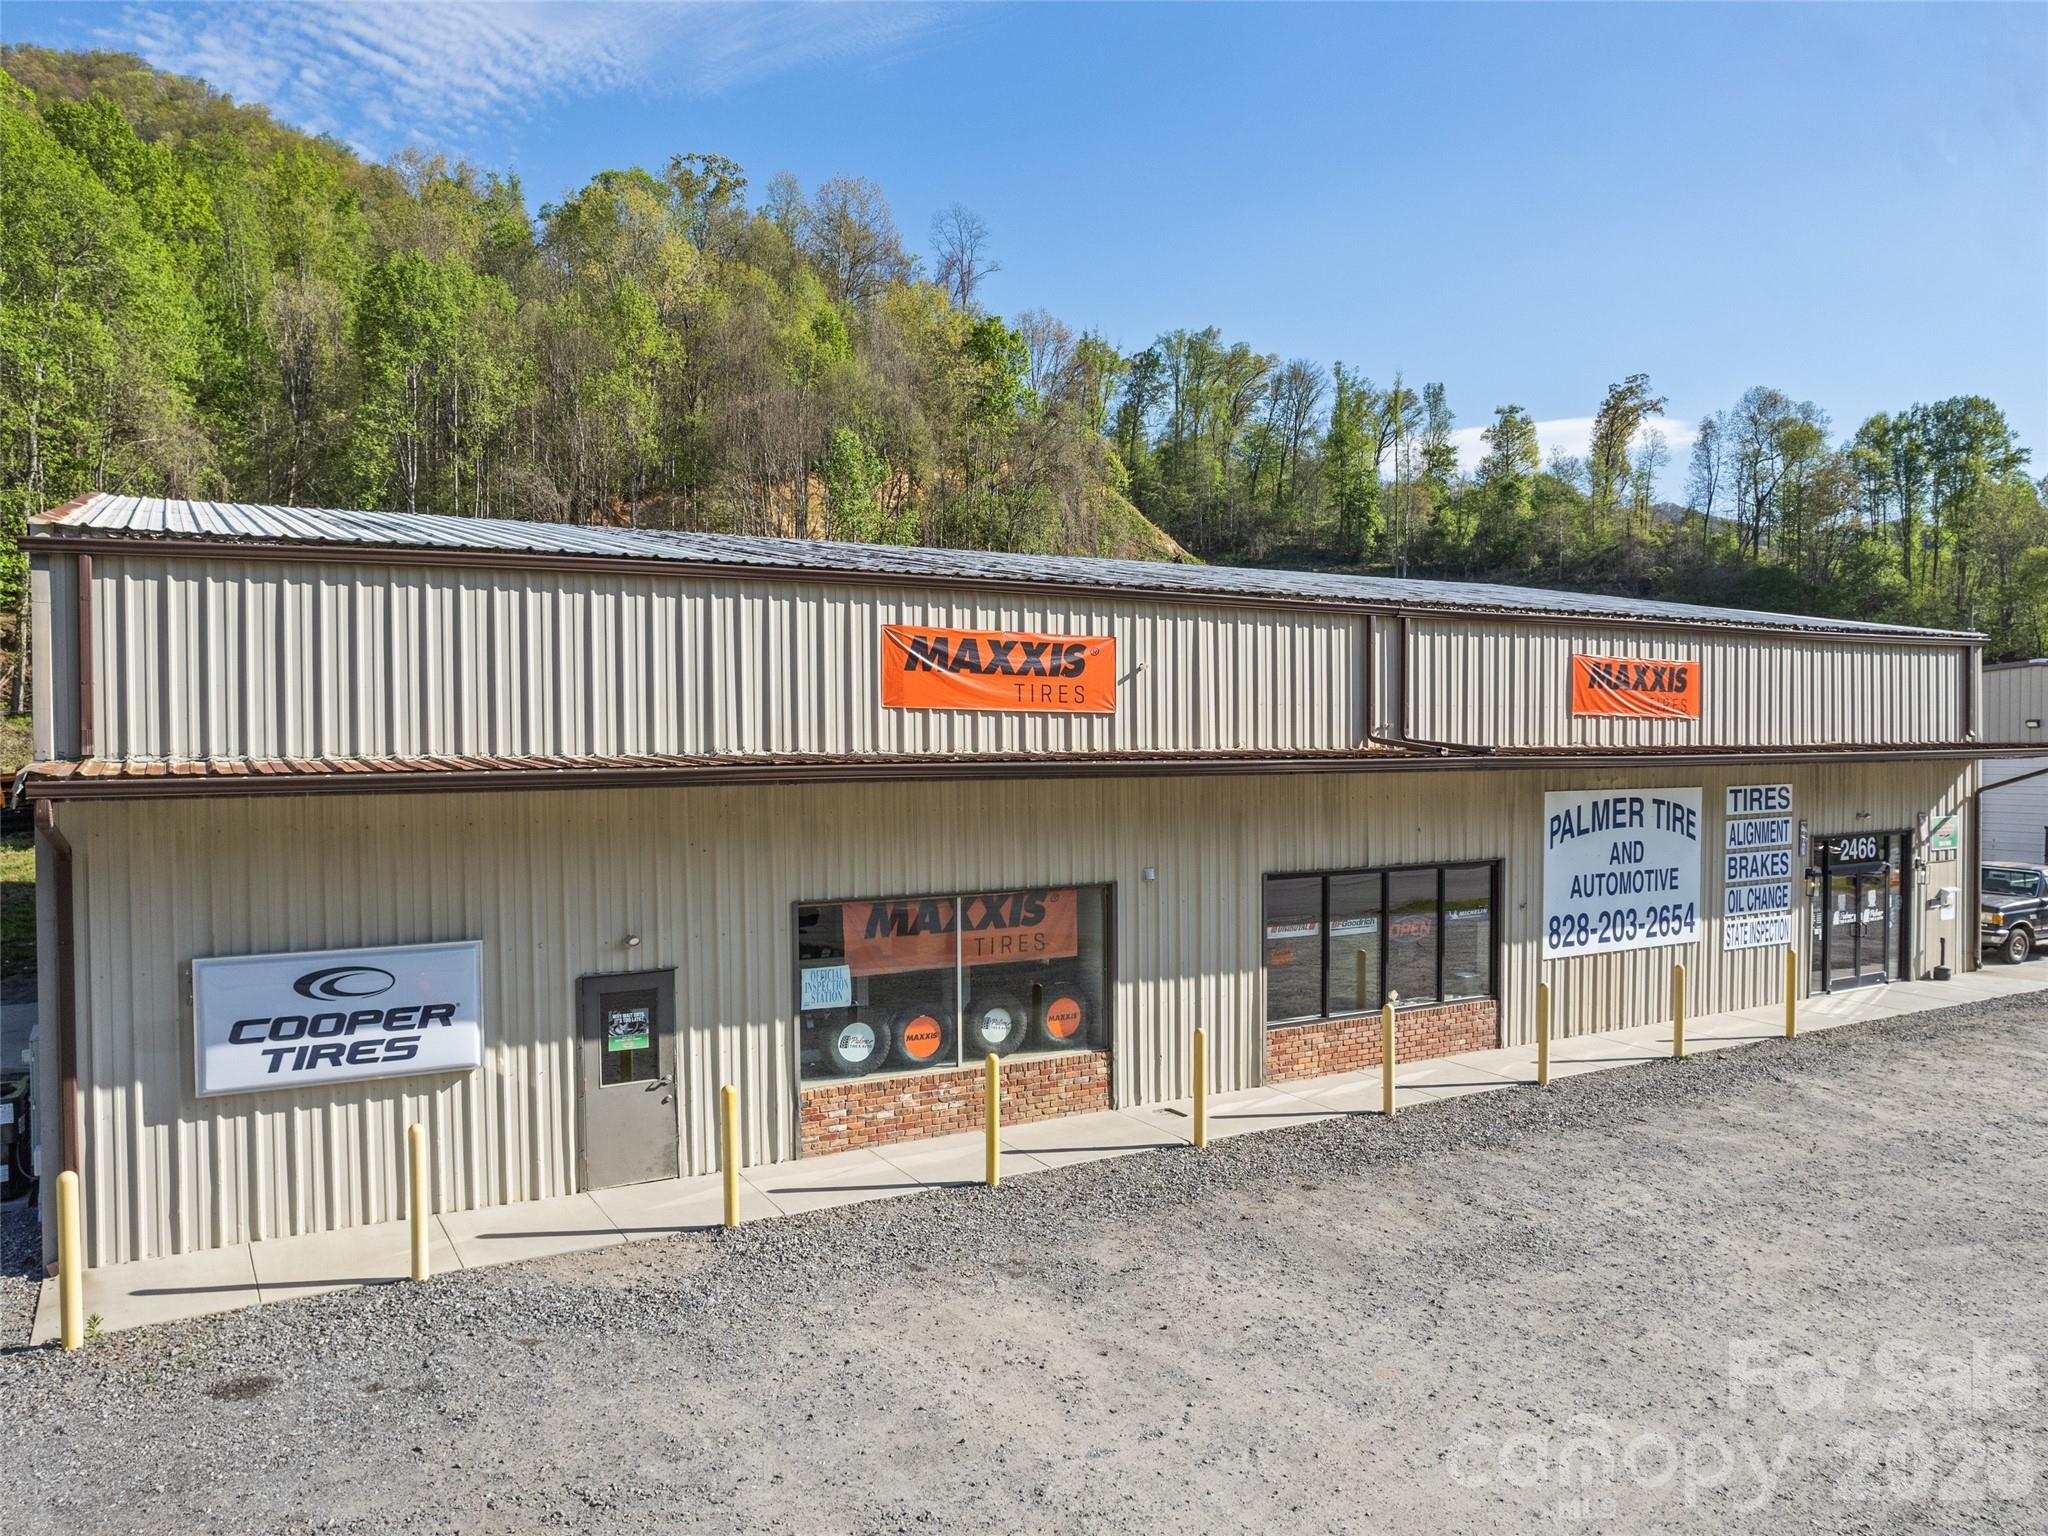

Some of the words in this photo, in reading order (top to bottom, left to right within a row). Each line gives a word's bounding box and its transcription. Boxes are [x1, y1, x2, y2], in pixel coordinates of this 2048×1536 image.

[904, 635, 1088, 678] MAXXIS
[1588, 662, 1688, 693] MAXXIS
[1014, 683, 1085, 704] TIRES
[1729, 786, 1790, 811] TIRES
[1550, 797, 1644, 849] PALMER
[1652, 798, 1696, 841] TIRE
[1729, 819, 1790, 846] ALIGNMENT
[1609, 840, 1644, 865] AND
[1840, 836, 1877, 861] 2466
[1728, 852, 1789, 880] BRAKES
[1570, 867, 1679, 899] AUTOMOTIVE
[1728, 888, 1744, 914] OIL
[1747, 885, 1788, 911] CHANGE
[1548, 901, 1696, 950] 828-203-2654
[1725, 921, 1748, 948] STATE
[1749, 919, 1789, 946] INSPECTION
[974, 931, 1046, 956] TIRES
[805, 978, 849, 993] INSPECTION
[810, 968, 843, 981] OFFICIAL
[811, 991, 842, 1004] STATION
[228, 1003, 457, 1046] COOPER
[1048, 1013, 1077, 1022] MAXXIS
[905, 1032, 938, 1042] MAXXIS
[261, 1036, 421, 1073] TIRES
